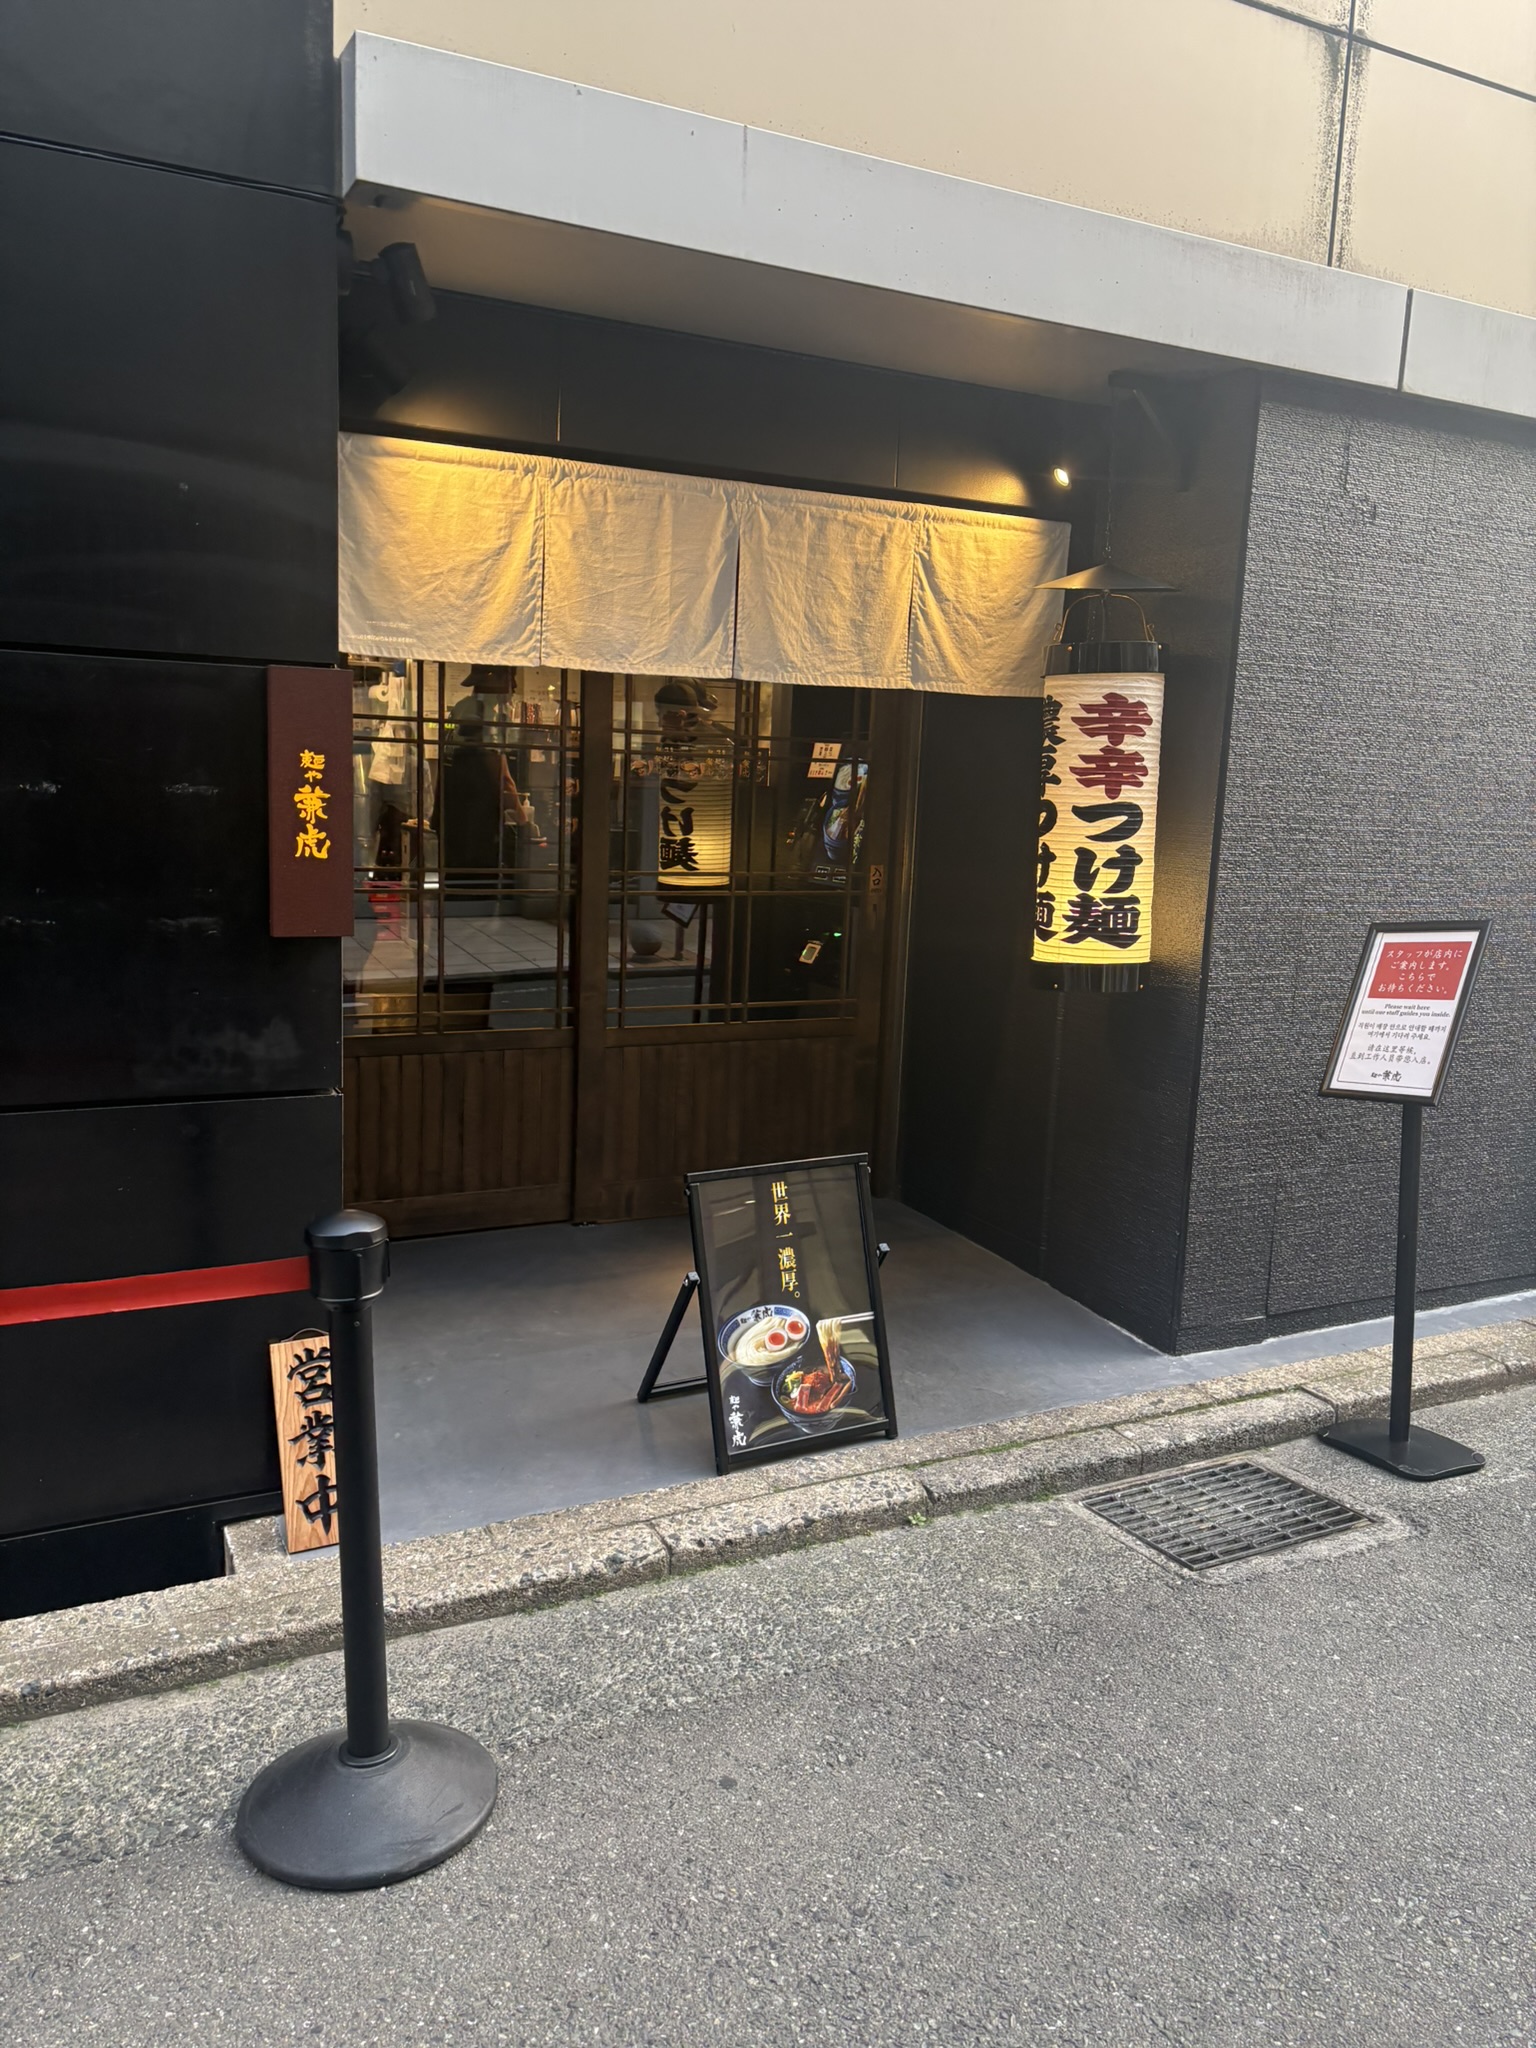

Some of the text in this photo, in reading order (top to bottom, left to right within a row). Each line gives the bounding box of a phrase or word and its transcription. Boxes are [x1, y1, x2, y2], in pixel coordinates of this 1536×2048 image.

[1060, 692, 1153, 949] 辛辛つけ麺
[1386, 948, 1463, 959] スタッフが店内に
[1390, 960, 1450, 972] ご案内します。
[1399, 973, 1437, 982] こちらで
[1378, 983, 1449, 995] お待ちください。
[770, 1180, 801, 1298] 世界一濃厚。
[286, 1347, 338, 1536] 営業中
